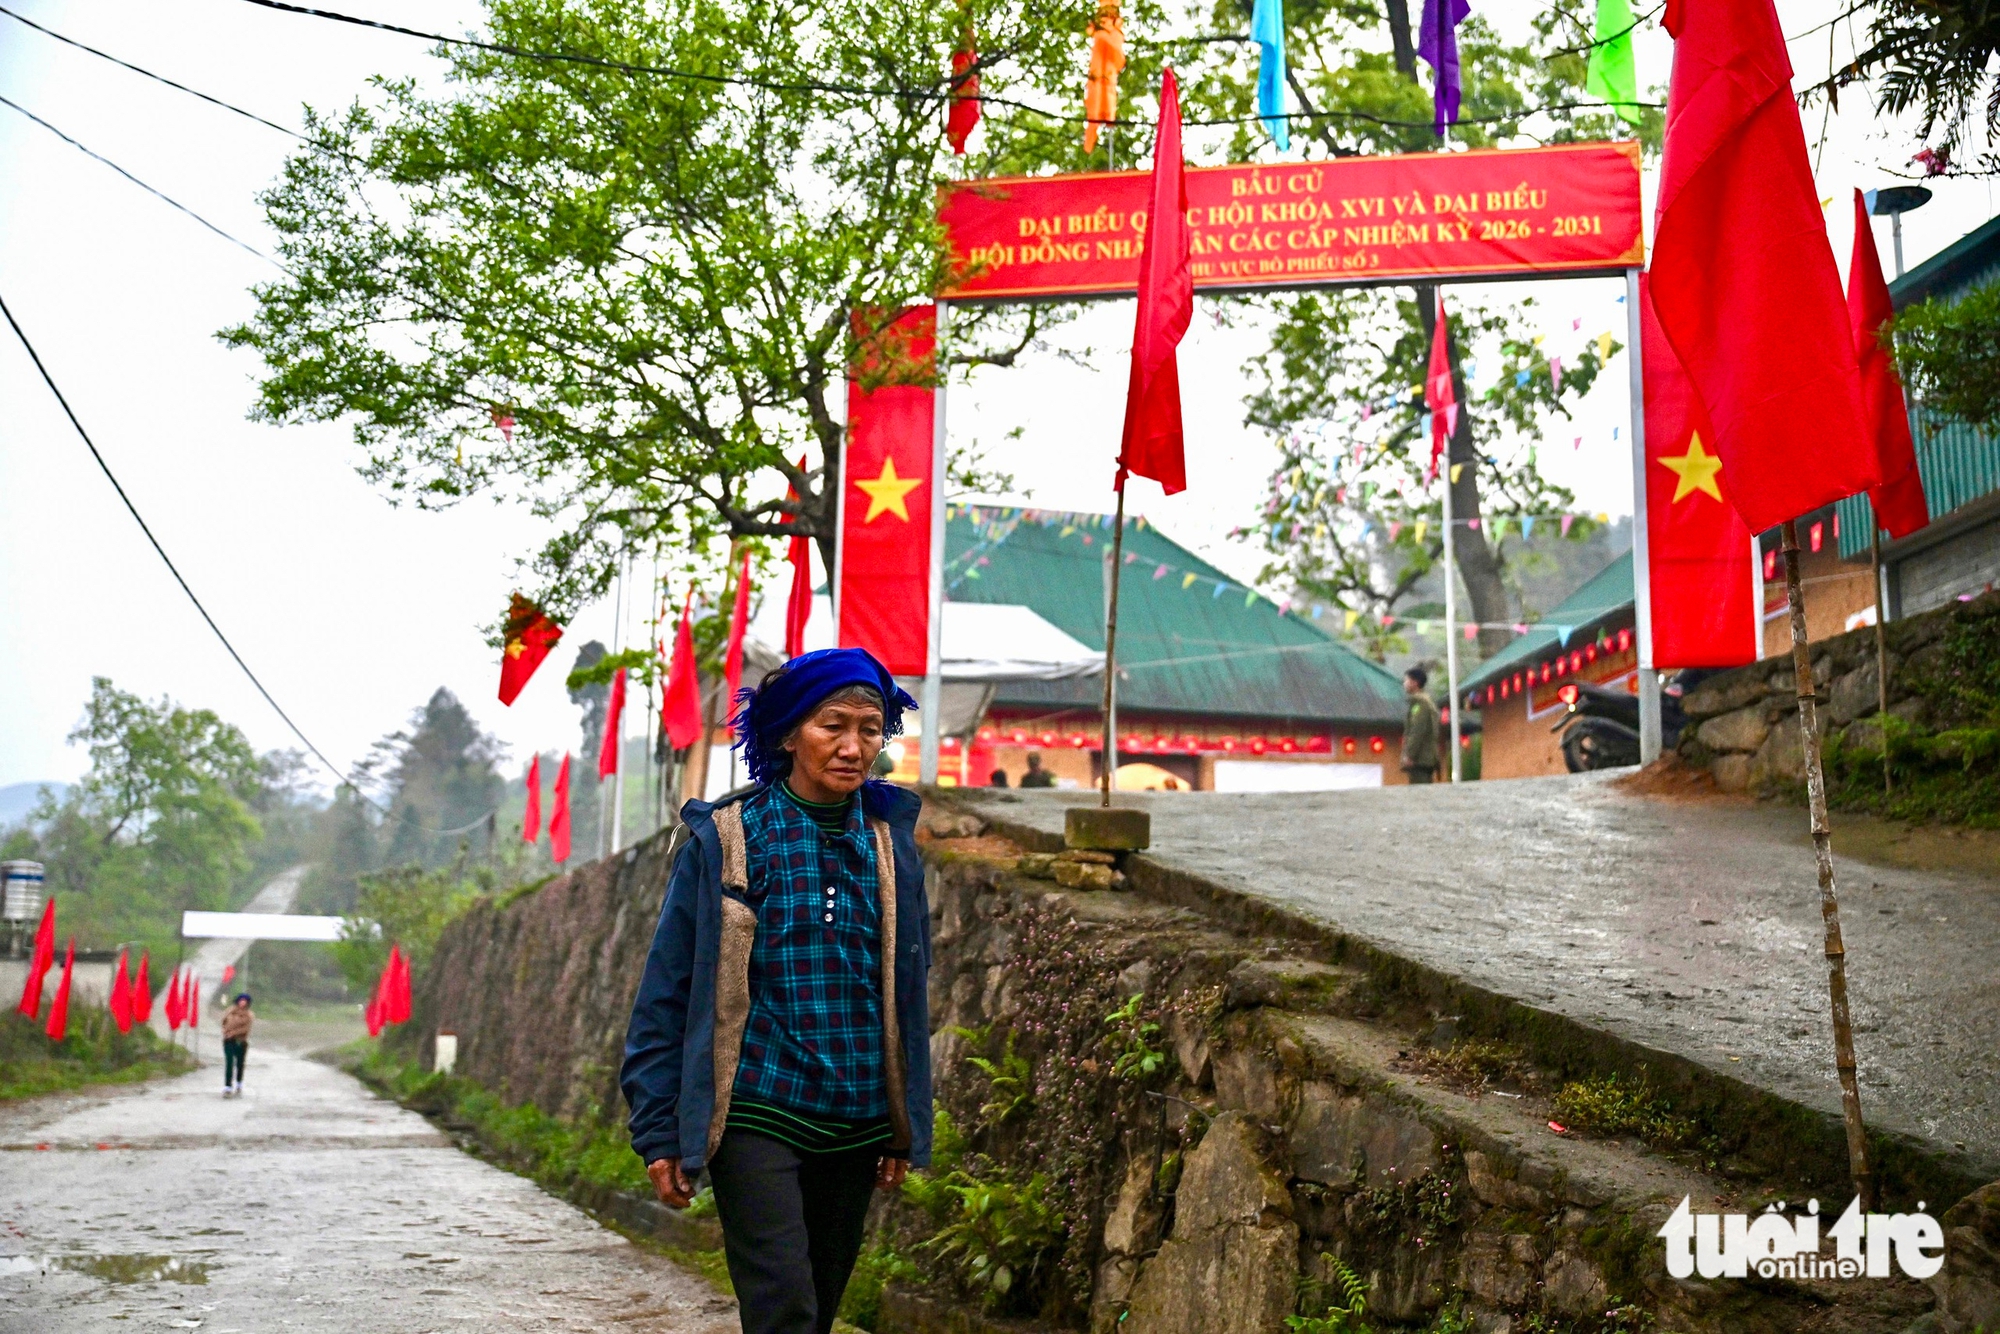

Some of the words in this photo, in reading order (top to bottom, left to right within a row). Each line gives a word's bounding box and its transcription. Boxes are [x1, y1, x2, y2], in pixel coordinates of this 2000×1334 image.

[1231, 168, 1282, 197] BẦU
[1287, 166, 1324, 194] CỬ
[1068, 204, 1125, 234] BIỂU
[1130, 207, 1202, 234] QC
[1208, 200, 1254, 229] HỘI
[1261, 196, 1334, 223] KHÓA
[1341, 197, 1385, 219] XVI
[1392, 190, 1427, 216] VÀ
[1486, 180, 1548, 212] BIỂU
[970, 241, 1015, 271] HỘI
[1020, 236, 1090, 265] ĐỒNG
[1096, 235, 1145, 260] NHÂ
[1189, 230, 1224, 255] ÂN
[1229, 227, 1282, 253] CÁC
[1287, 220, 1339, 251] CẤP
[1344, 219, 1429, 250] NHIỆM
[1437, 213, 1474, 243] KỲ
[1479, 218, 1532, 241] 2026
[1536, 226, 1546, 234] -
[1551, 215, 1602, 238] 2031
[1191, 262, 1217, 277] HU
[1342, 248, 1367, 269] SỐ
[1369, 253, 1380, 268] 3
